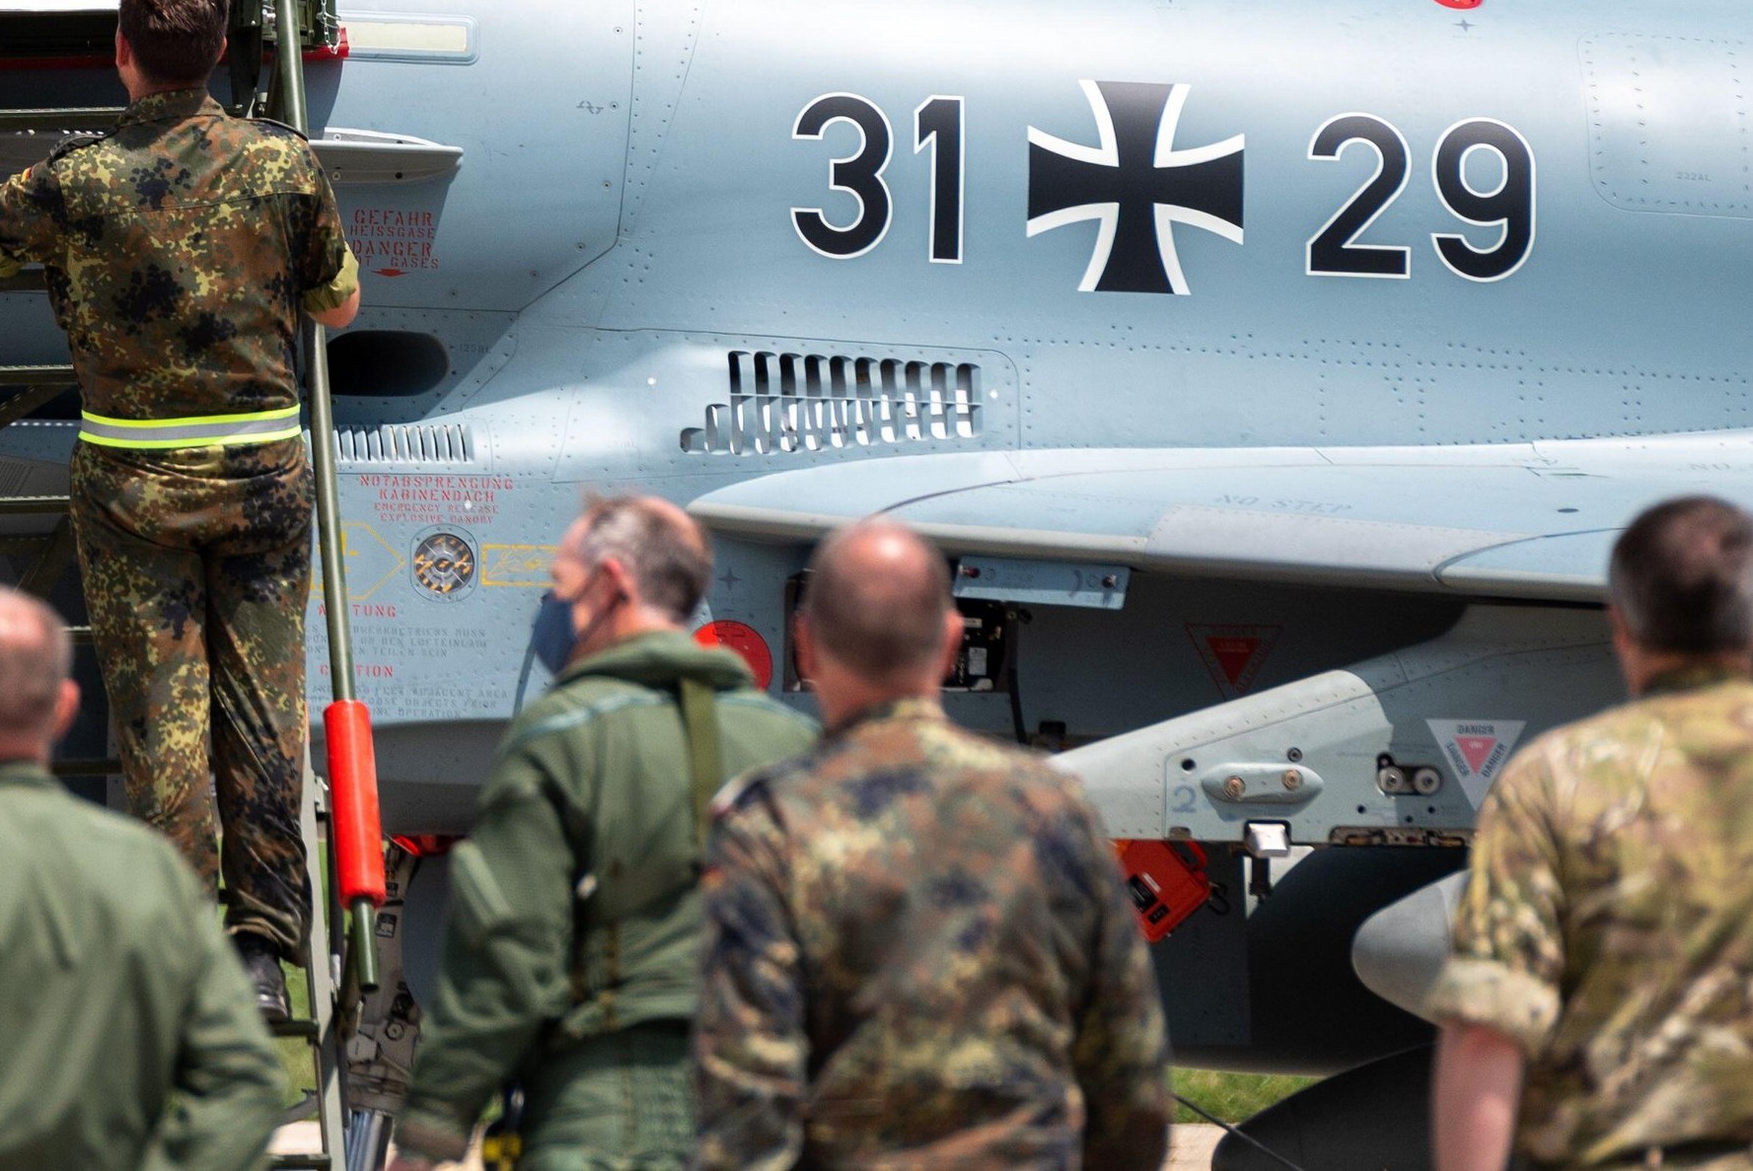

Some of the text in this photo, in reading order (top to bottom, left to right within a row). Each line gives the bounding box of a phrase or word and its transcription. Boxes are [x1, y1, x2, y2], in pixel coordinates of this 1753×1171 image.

[790, 92, 965, 264] 31
[1306, 112, 1537, 283] 29
[354, 208, 433, 227] GEFAHR
[350, 224, 436, 240] HEISSGASE
[351, 239, 432, 258] DANGER
[390, 256, 440, 269] GASES
[360, 475, 514, 490] NOTABSPRENGUNG
[378, 488, 495, 503] KABINENDACH
[374, 502, 441, 513] EMERGENCY
[380, 512, 495, 525] EXPLOSIVE CANOPY
[1457, 724, 1495, 735] DANGER
